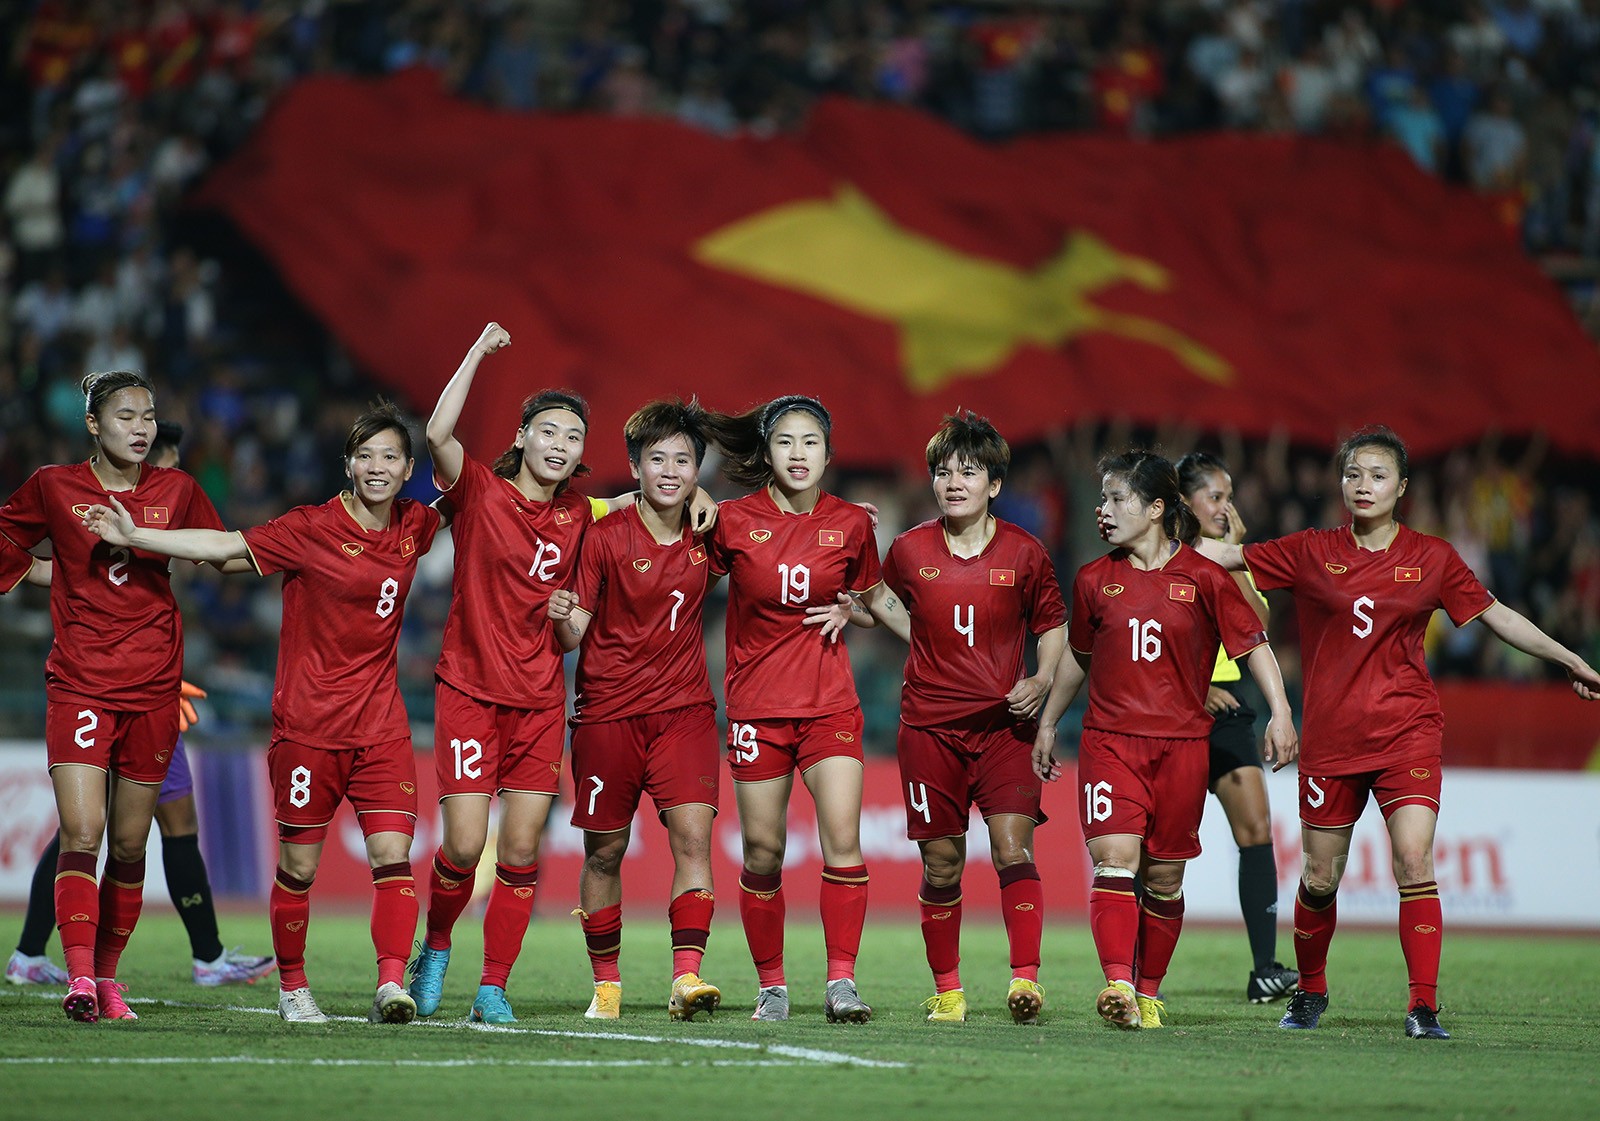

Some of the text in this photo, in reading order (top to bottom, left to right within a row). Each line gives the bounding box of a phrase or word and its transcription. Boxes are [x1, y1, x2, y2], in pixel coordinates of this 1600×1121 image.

[108, 545, 130, 587] 2
[528, 536, 561, 582] 12
[375, 576, 399, 619] 8
[777, 562, 811, 605] 19
[668, 589, 685, 633] 7
[953, 604, 975, 648] 4
[1128, 617, 1162, 663] 16
[74, 709, 99, 750] 2
[732, 722, 760, 764] 19
[450, 737, 483, 781] 12
[289, 765, 312, 809] 8
[587, 775, 606, 816] 7
[907, 781, 932, 824] 4
[1084, 780, 1113, 825] 16
